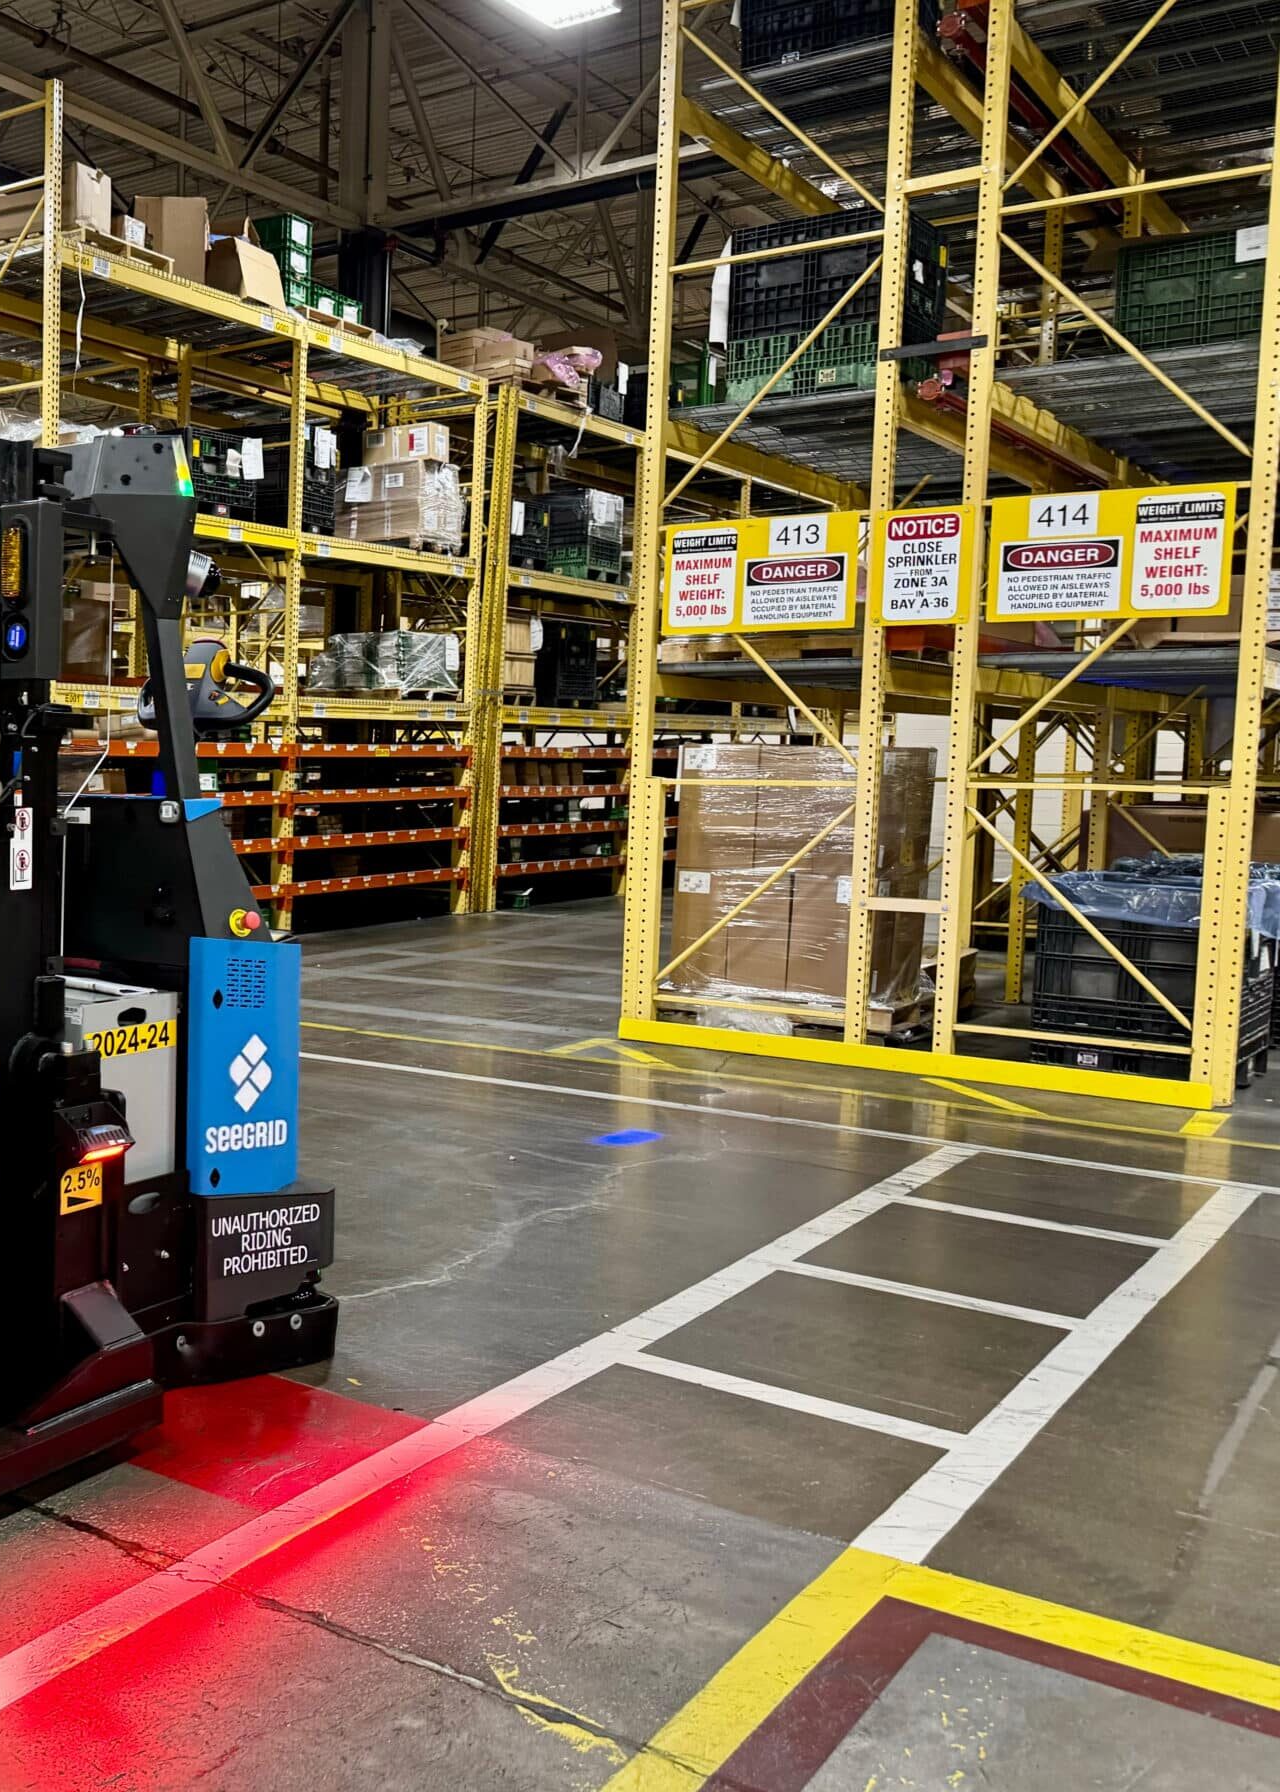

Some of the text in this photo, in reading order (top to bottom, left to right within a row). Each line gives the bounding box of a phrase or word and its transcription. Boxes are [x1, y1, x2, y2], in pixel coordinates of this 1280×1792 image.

[1037, 503, 1090, 528] 414
[1138, 502, 1224, 516] WEIGHT LIMITS
[891, 518, 956, 537] NOTICE
[674, 536, 736, 548] WEIGHT LIMITS
[776, 524, 820, 546] 413
[1140, 527, 1217, 543] MAXIMUM
[902, 541, 942, 554] CLOSE
[1154, 546, 1201, 560] SHELF
[888, 553, 957, 568] SPRINKLER
[1021, 548, 1100, 564] DANGER
[676, 557, 732, 571] MAXIMUM
[1144, 564, 1208, 578] WEIGHT:
[762, 564, 828, 579] DANGER
[910, 568, 932, 576] FROM
[1021, 574, 1074, 582] PEDESTRIAN
[1076, 572, 1112, 580] TRAFFIC
[686, 574, 720, 586] SHELF
[894, 576, 948, 588] ZONE 3A
[1008, 584, 1048, 592] ALLOWED
[1061, 582, 1110, 590] AISLEWAYS
[679, 589, 725, 600] WEIGHT:
[762, 588, 806, 596] PEDESTRIAN
[1140, 582, 1210, 598] 5,000 lbs
[796, 594, 837, 602] AISLEWAYS
[890, 597, 949, 610] BAY A-36
[1010, 600, 1104, 610] HANDLING EQUIPMENT
[676, 604, 727, 618] 5,000 lbs
[92, 1022, 170, 1056] 2024-24
[64, 1168, 100, 1194] 2.5%
[212, 1204, 320, 1238] UNAUTHORIZED
[242, 1227, 292, 1252] RIDING
